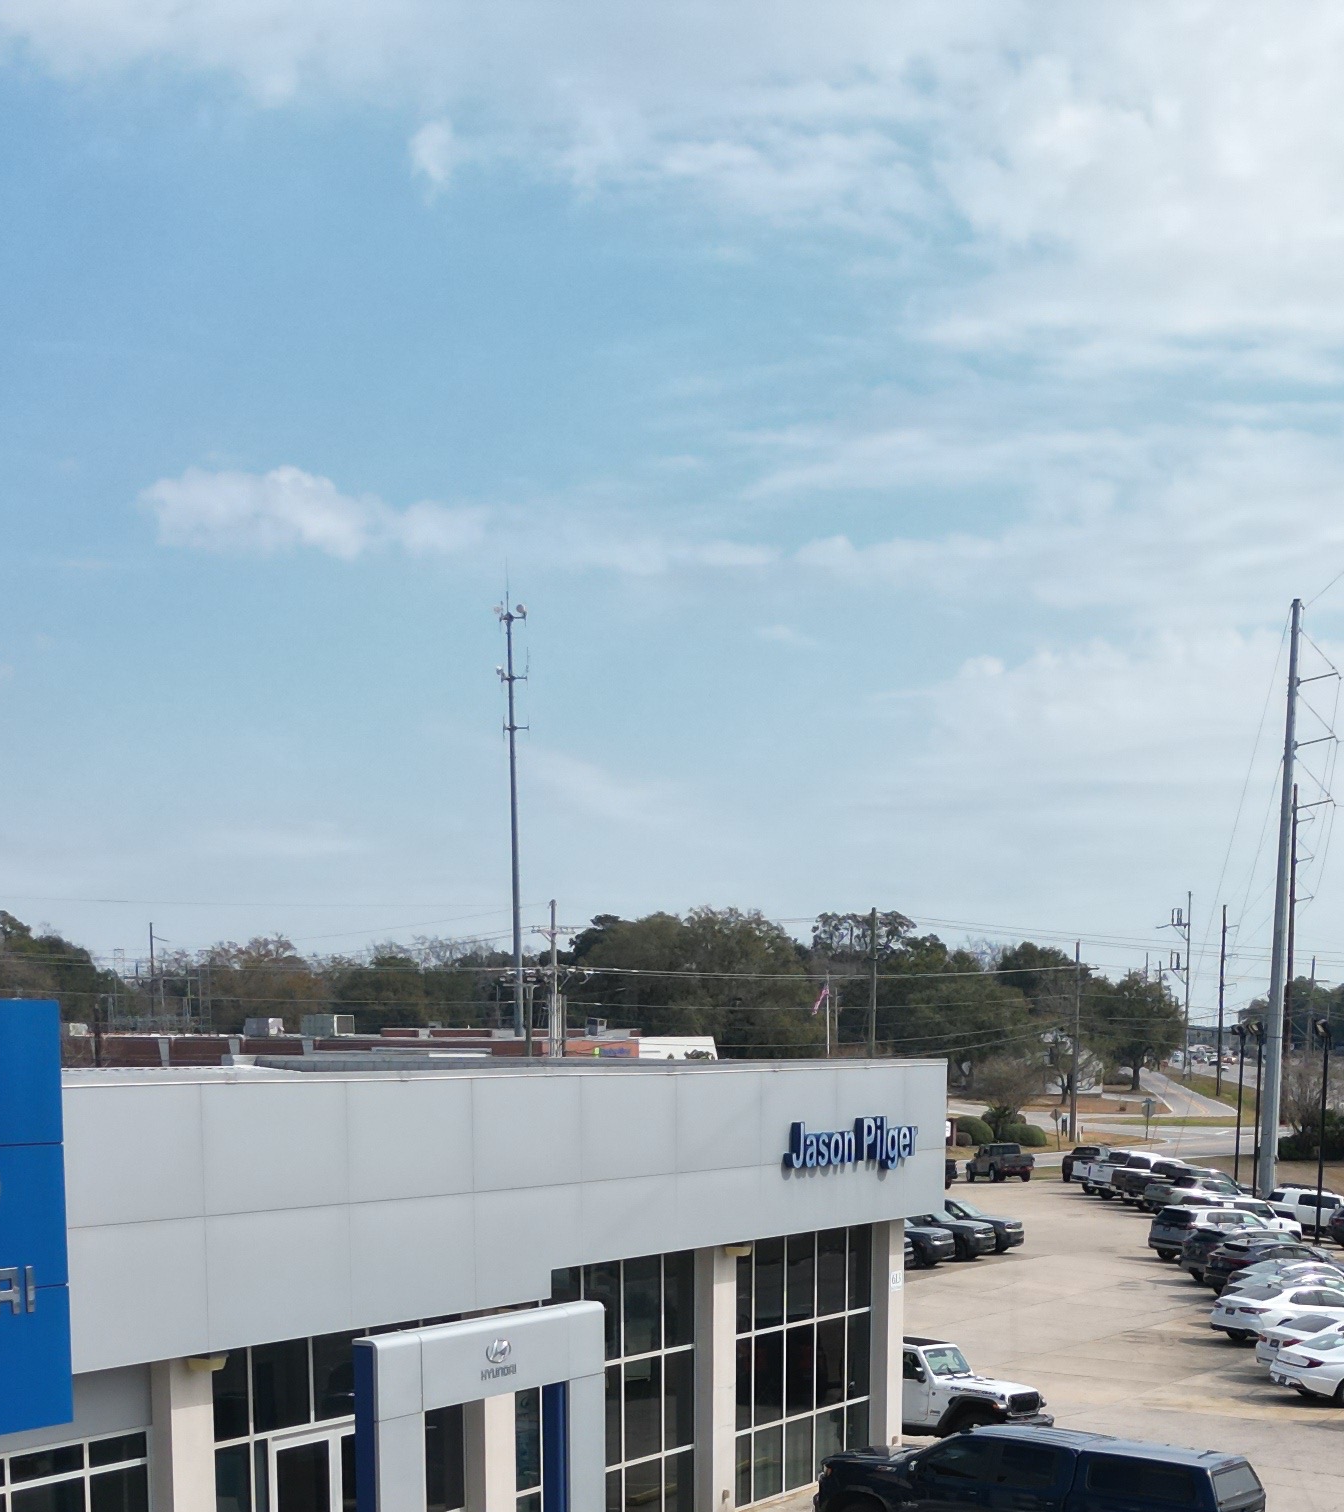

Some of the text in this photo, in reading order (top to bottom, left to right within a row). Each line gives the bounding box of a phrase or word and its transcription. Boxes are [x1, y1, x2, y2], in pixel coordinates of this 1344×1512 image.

[787, 1116, 918, 1170] Jason Pilger
[480, 1363, 517, 1381] HYUNDAI
